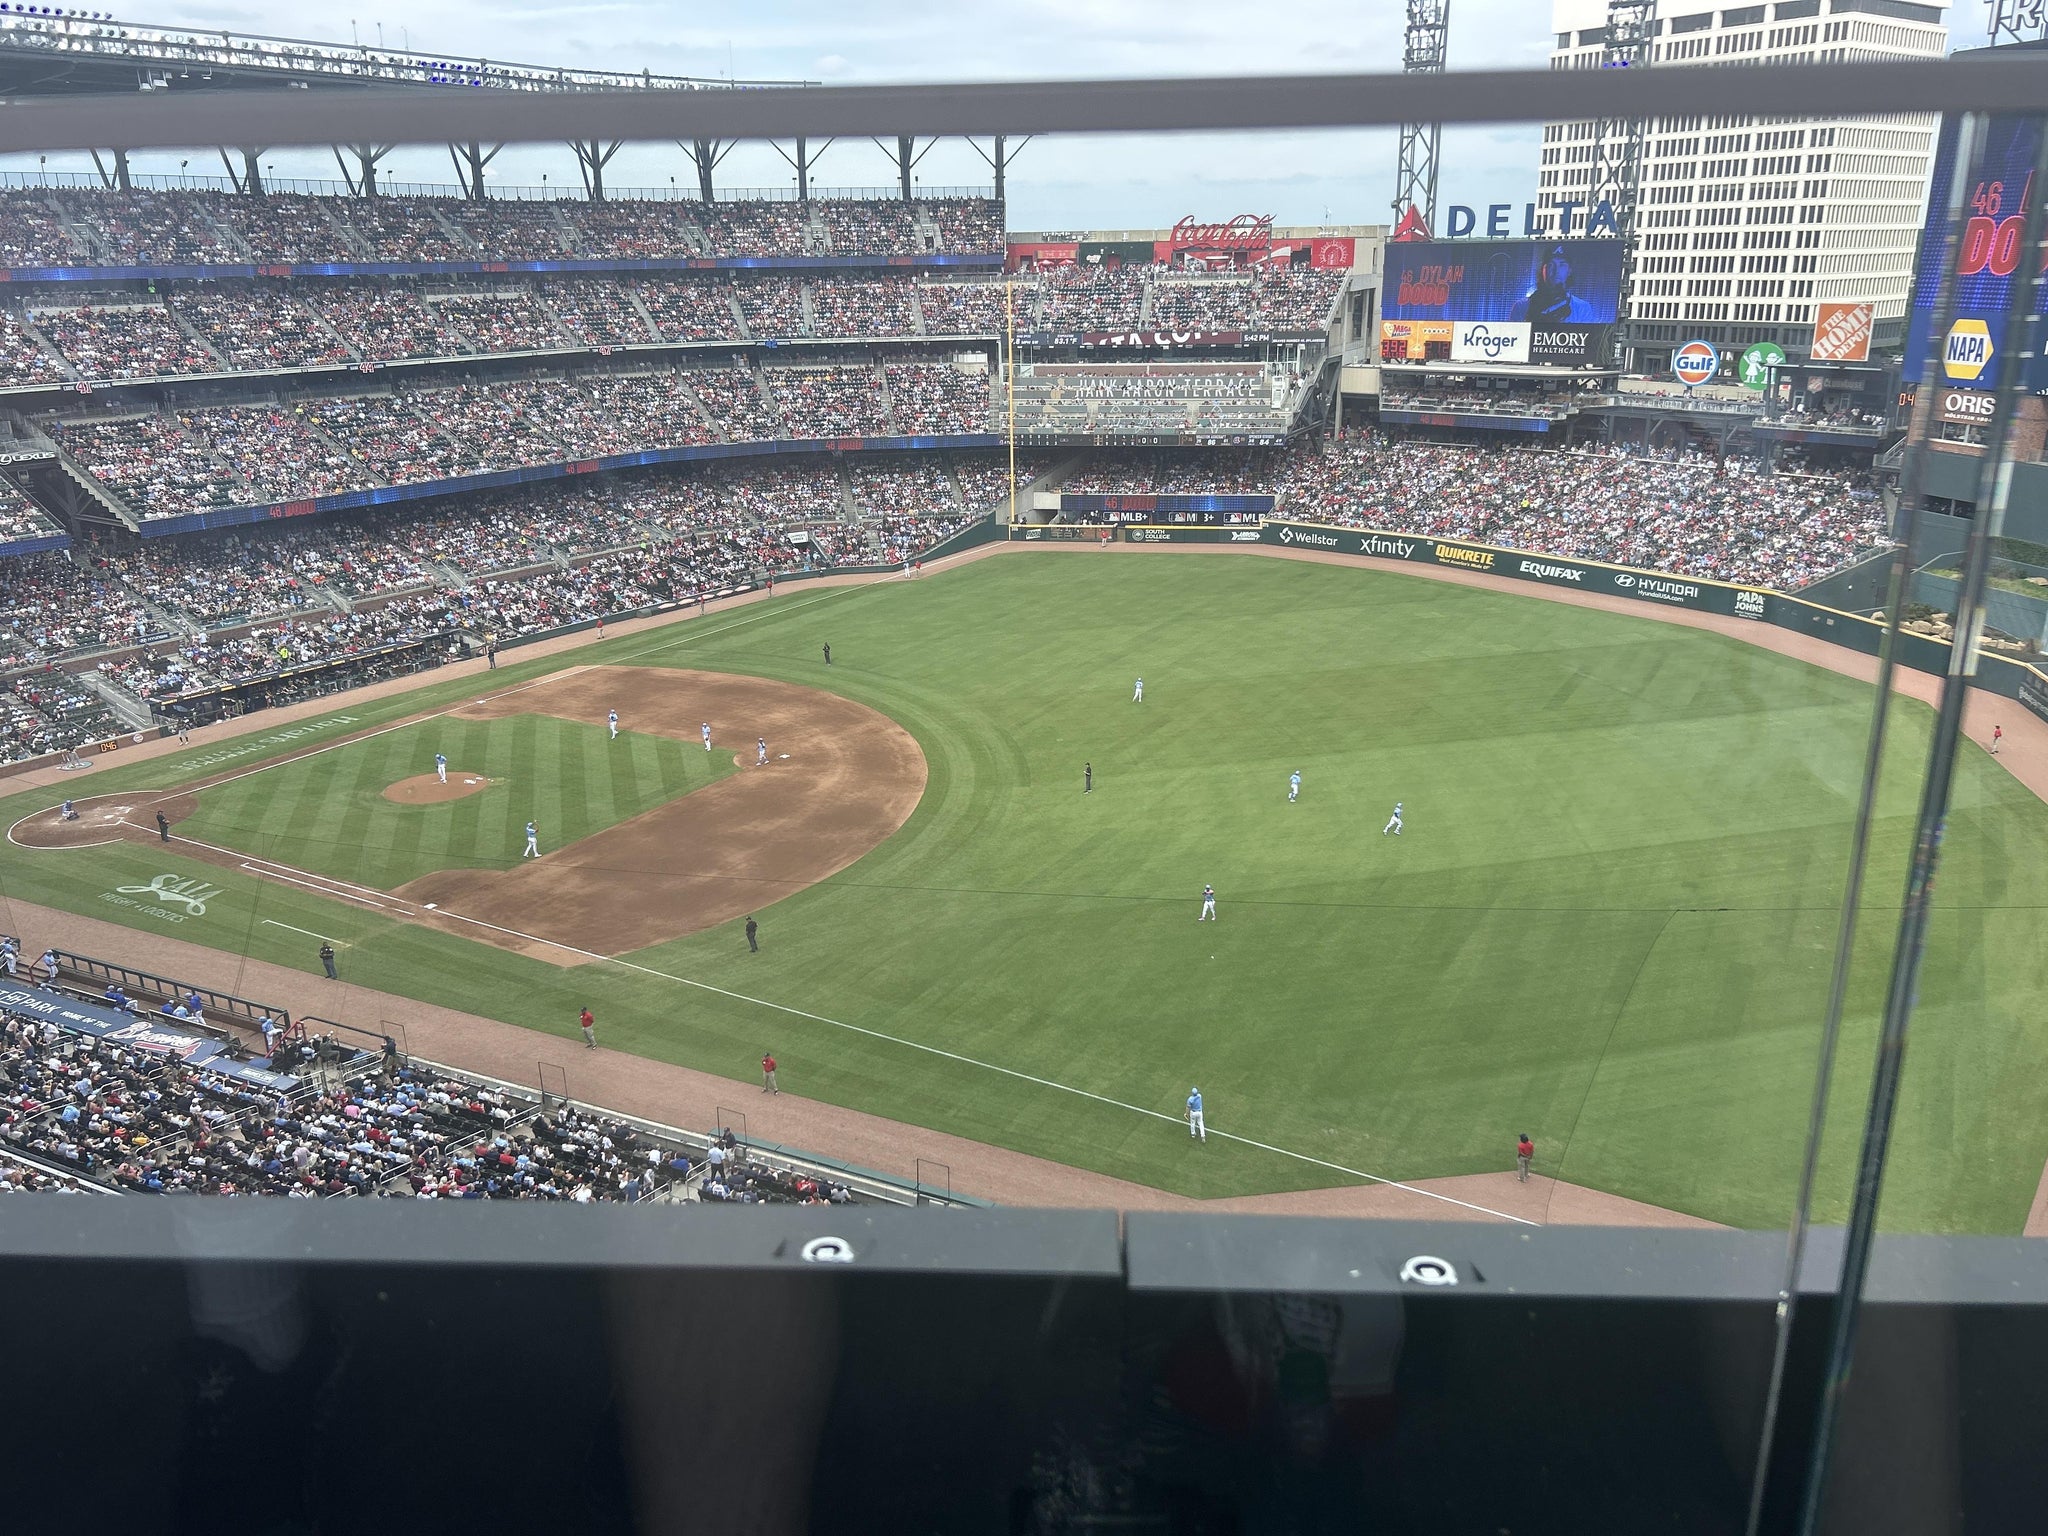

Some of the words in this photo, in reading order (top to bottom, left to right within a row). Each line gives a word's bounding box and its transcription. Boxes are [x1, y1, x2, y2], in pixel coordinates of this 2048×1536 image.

[1447, 200, 1617, 237] DELTA
[1170, 213, 1277, 250] Coca-Cola
[1821, 308, 1846, 332] THE
[1463, 324, 1518, 357] Kroger
[1533, 332, 1589, 347] EMORY
[1814, 303, 1873, 359] HOME
[1533, 346, 1585, 355] HEALTHCARE
[1833, 325, 1870, 359] DEPOT
[1947, 335, 1984, 364] NAPA
[1676, 356, 1714, 371] Gulf
[76, 381, 92, 394] 41
[1075, 379, 1117, 398] HANK
[1122, 379, 1176, 398] AARON
[1184, 379, 1256, 398] TERRACE
[1945, 393, 1996, 415] ORIS
[12, 451, 56, 462] LEXUS
[1121, 512, 1148, 521] MLB+
[1295, 531, 1338, 546] Wellstar
[1360, 535, 1415, 558] xfinity
[1435, 544, 1494, 565] QUIKRETE
[1520, 560, 1581, 581] EQUIFAX
[1638, 578, 1698, 598] HYUNDAI
[1737, 592, 1763, 605] PAPA
[1735, 602, 1763, 613] JOHNS
[20, 999, 61, 1014] PARK
[60, 1010, 85, 1020] HOME
[93, 1020, 112, 1028] THE
